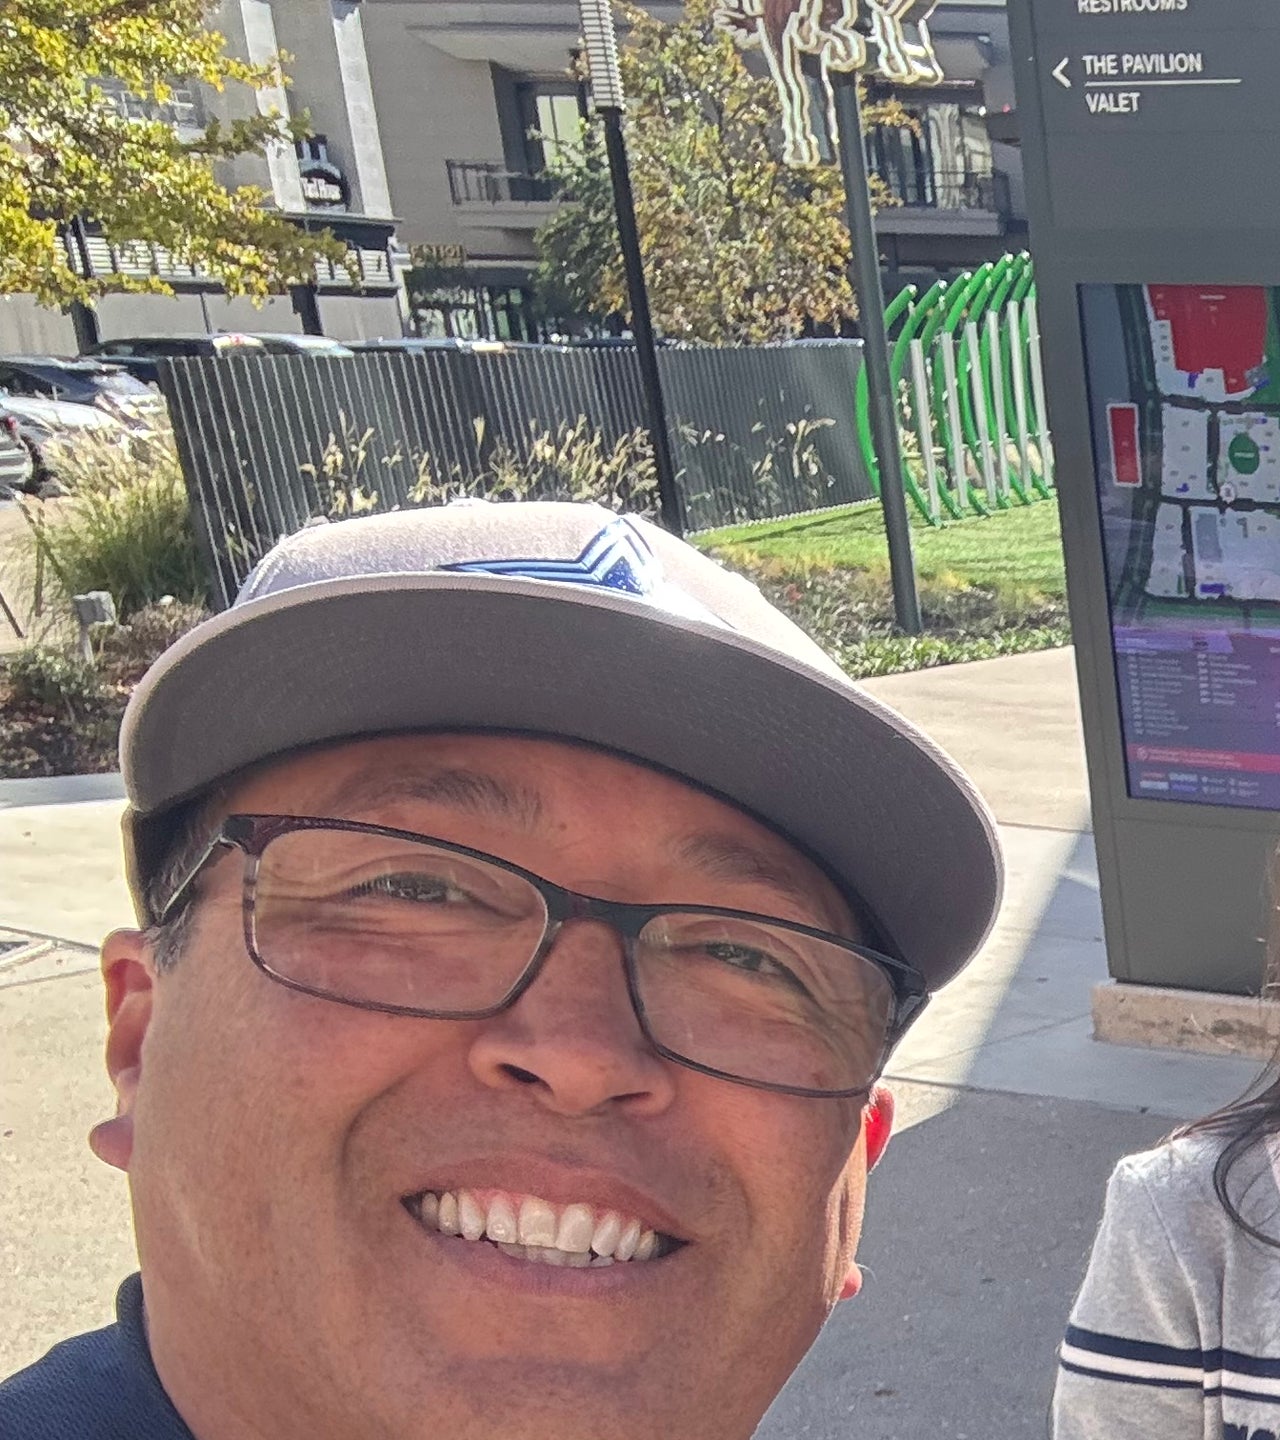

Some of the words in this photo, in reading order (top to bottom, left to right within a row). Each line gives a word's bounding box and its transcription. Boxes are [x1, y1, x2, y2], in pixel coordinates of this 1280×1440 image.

[1077, 0, 1188, 13] RESTROOMS
[1082, 54, 1119, 75] THE
[1122, 53, 1204, 74] PAVILION
[1085, 92, 1141, 113] VALET
